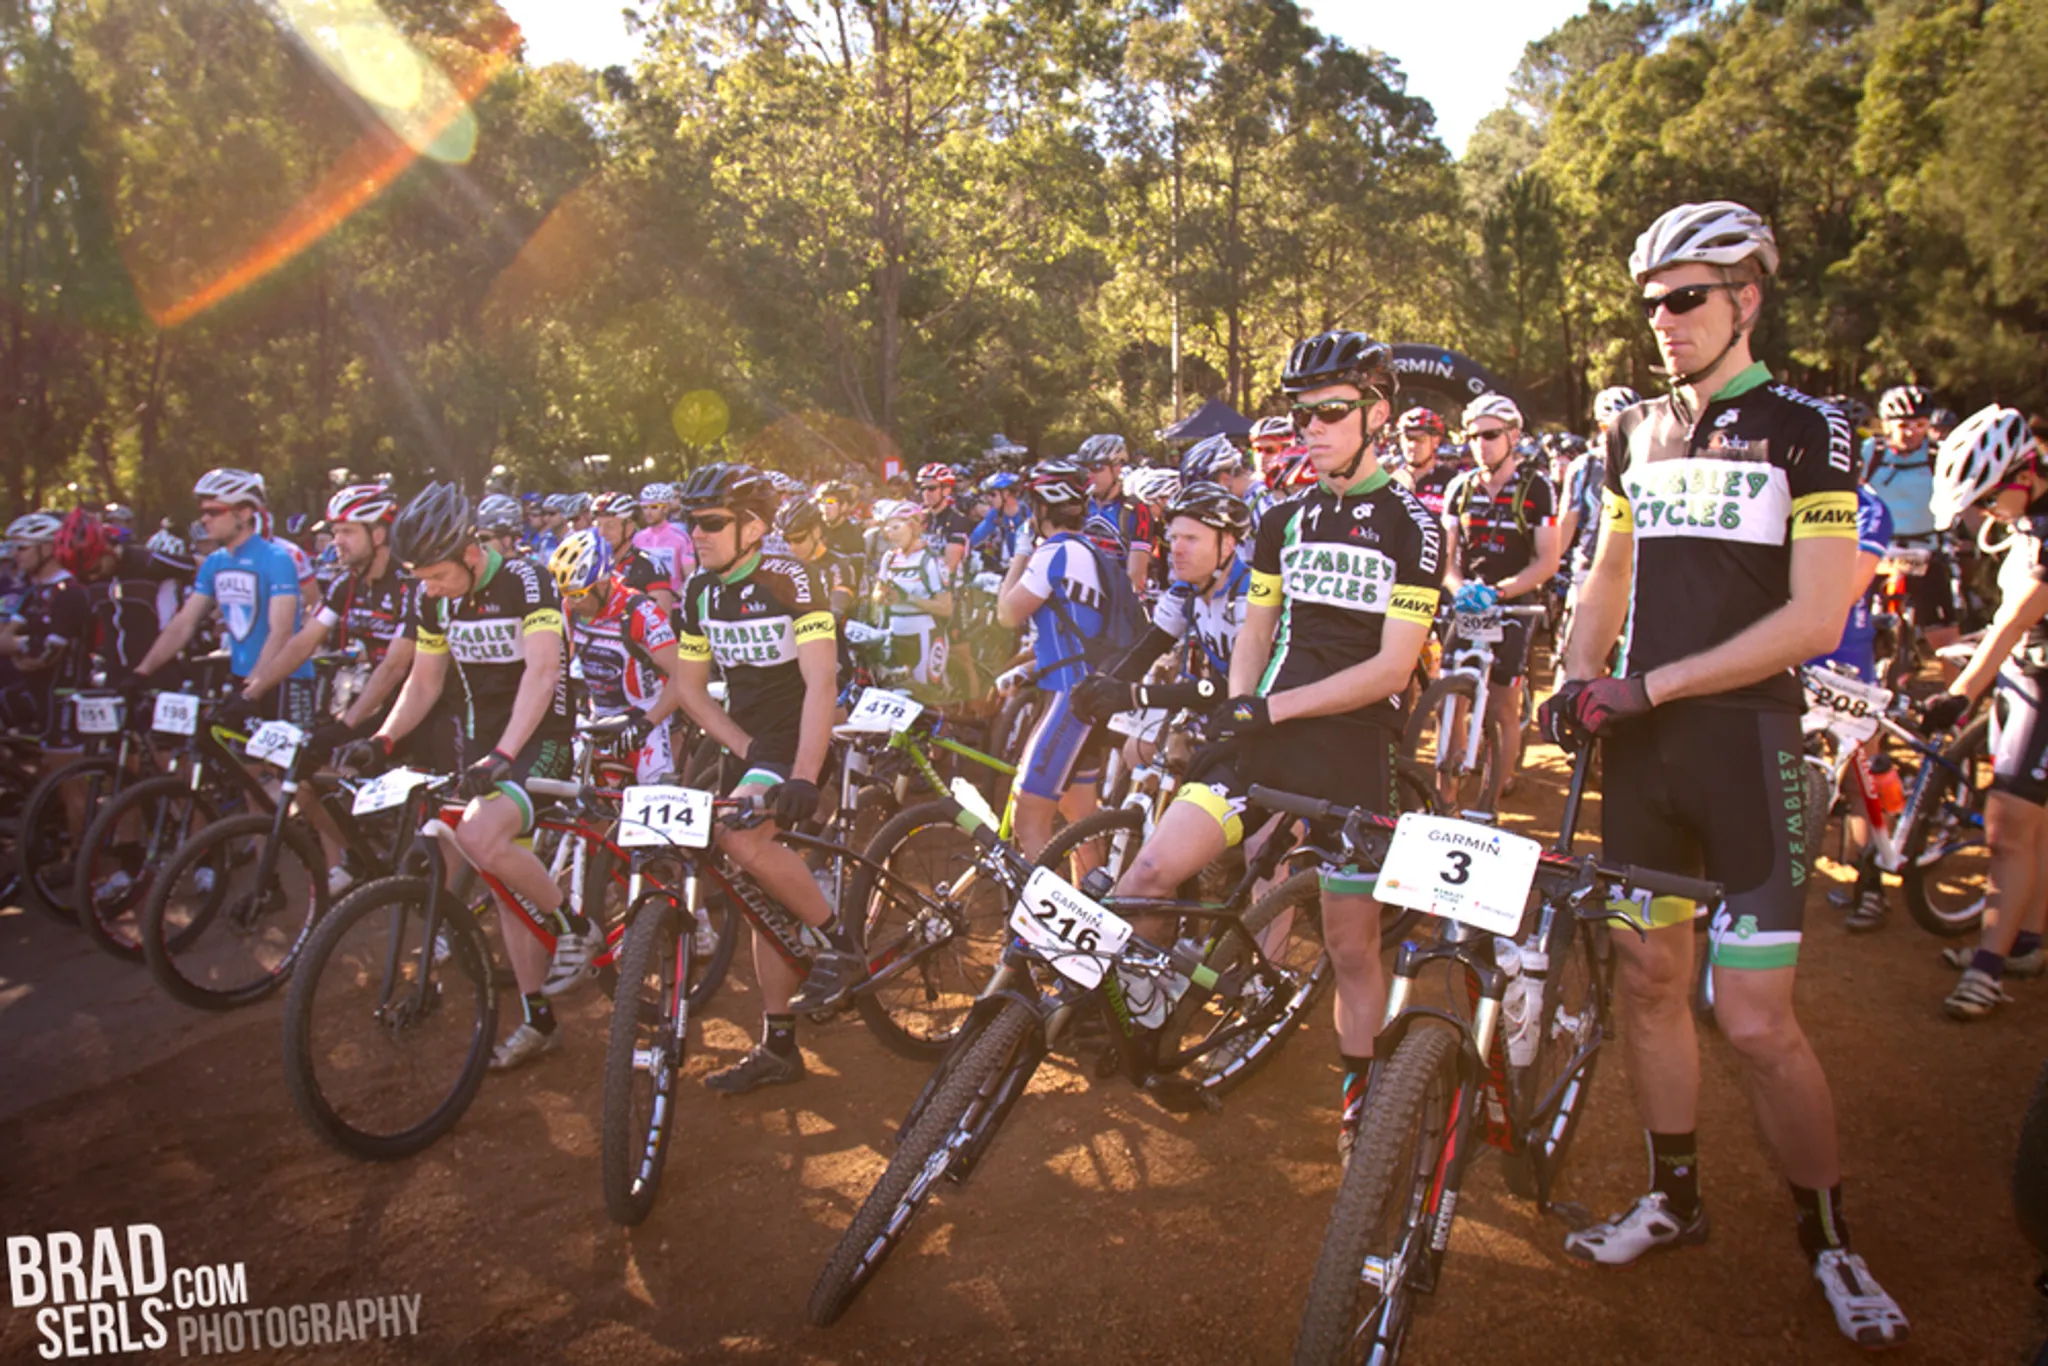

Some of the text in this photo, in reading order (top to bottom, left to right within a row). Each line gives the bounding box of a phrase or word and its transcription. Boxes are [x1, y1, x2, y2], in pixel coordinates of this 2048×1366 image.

[1393, 358, 1455, 380] RMIN
[1289, 571, 1378, 604] CYCLES
[1814, 686, 1868, 718] 208
[638, 803, 694, 827] 114
[1428, 829, 1501, 856] GARMIN
[1439, 850, 1472, 885] 3
[1051, 889, 1103, 928] GARMIN
[1033, 899, 1101, 951] 216
